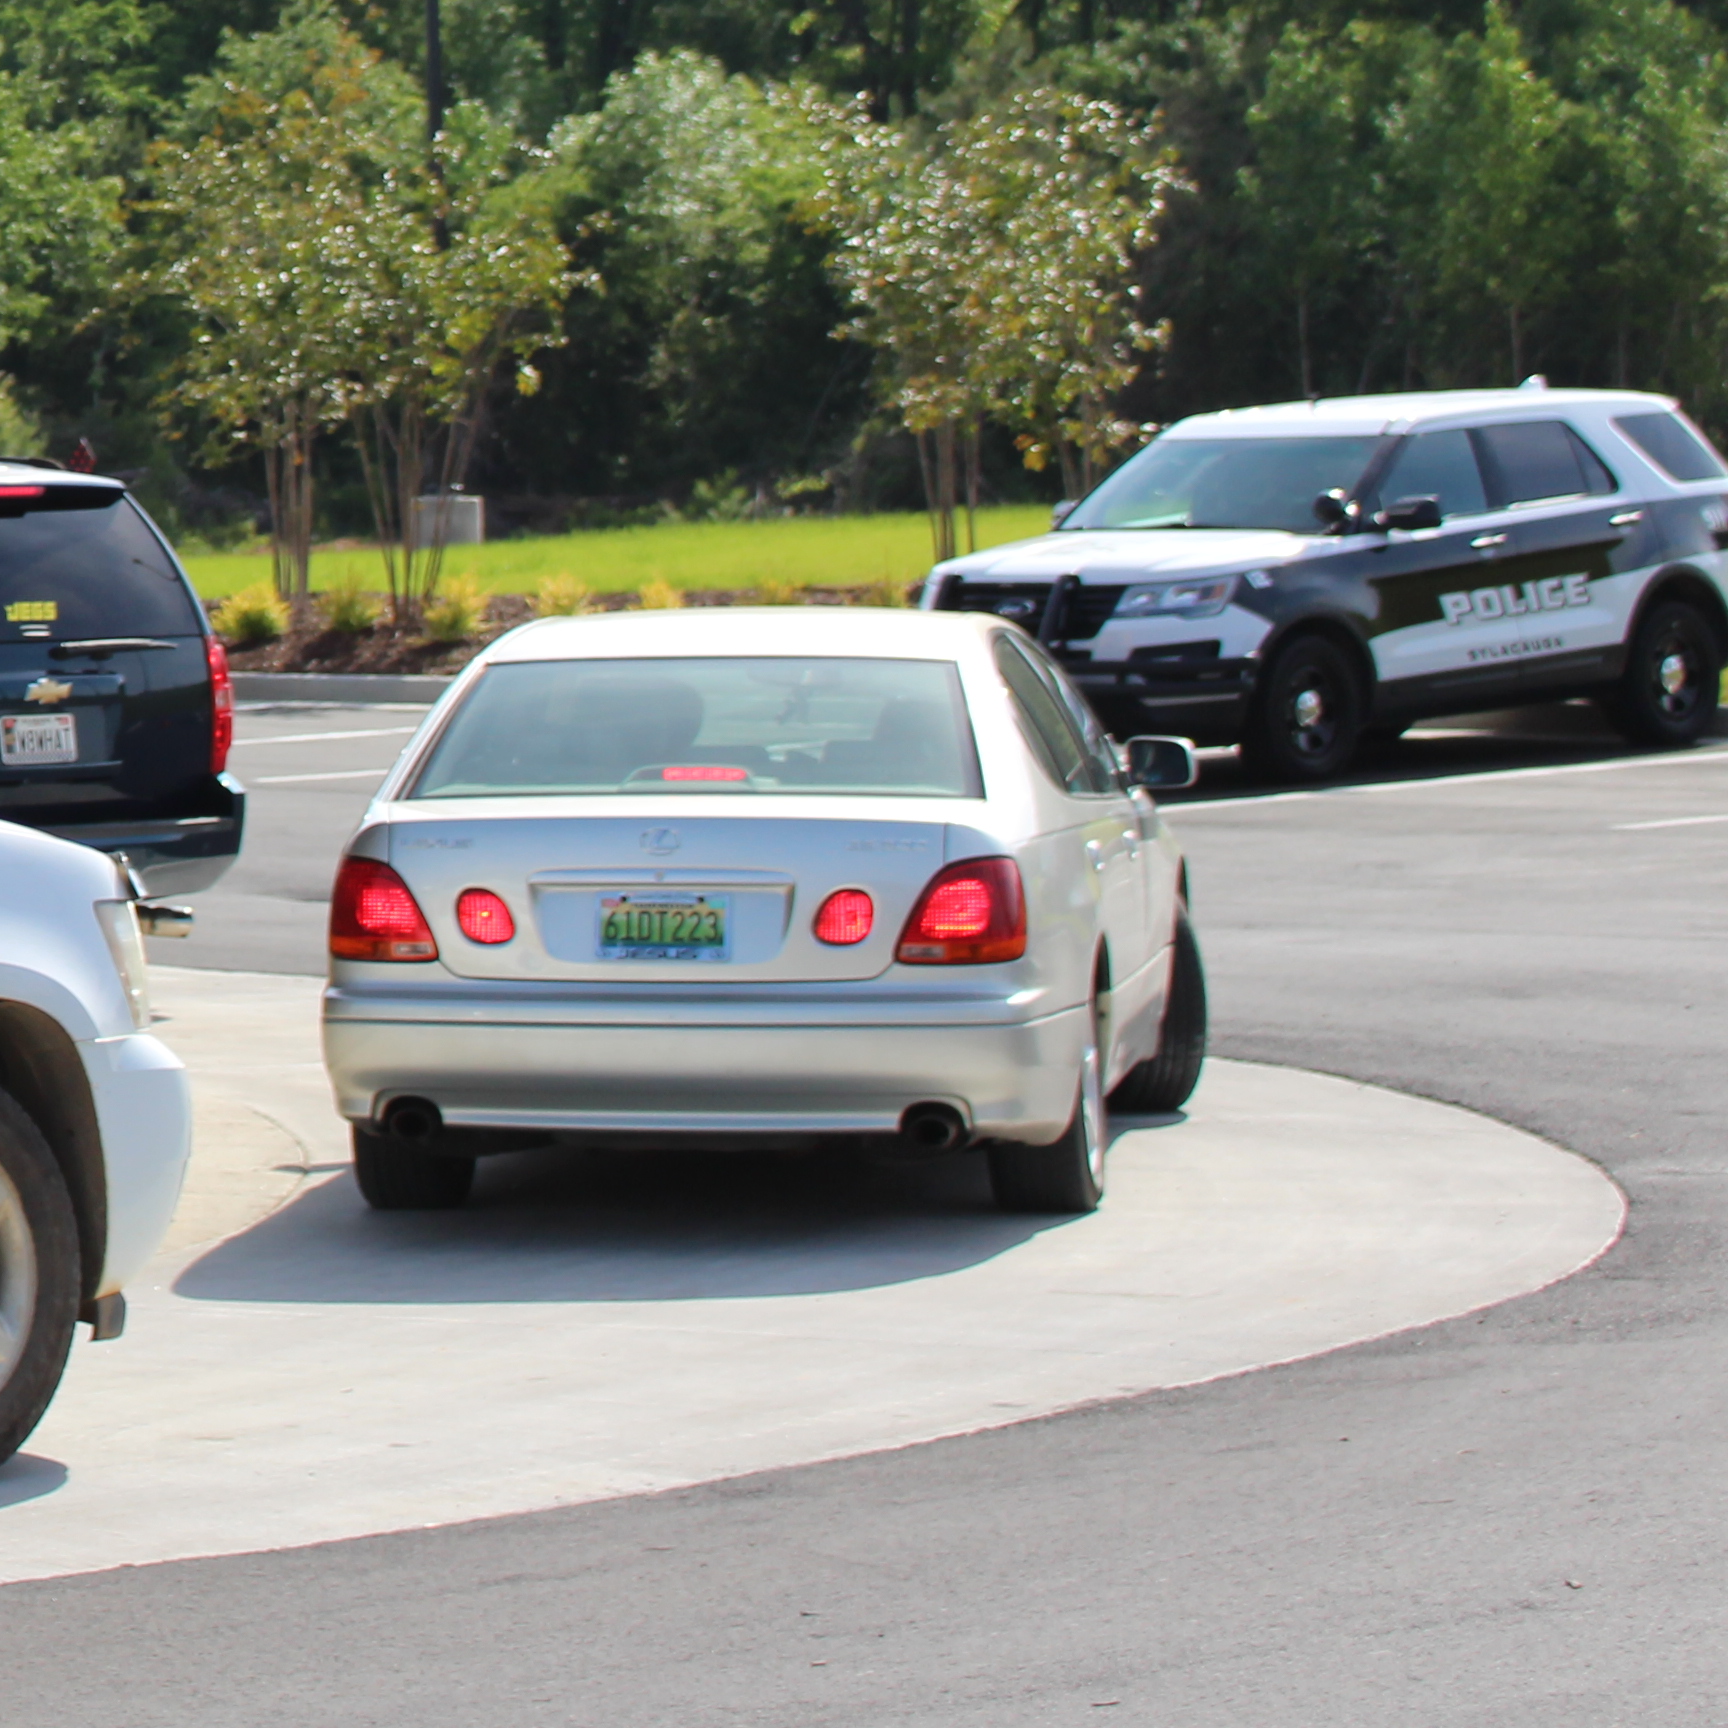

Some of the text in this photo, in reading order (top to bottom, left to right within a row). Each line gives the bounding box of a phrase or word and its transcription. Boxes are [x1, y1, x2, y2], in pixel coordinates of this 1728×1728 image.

[5, 601, 58, 621] JEGS
[1439, 572, 1591, 626] POLICE
[1467, 637, 1563, 662] SYLACAUGA
[604, 910, 718, 941] 61DT223
